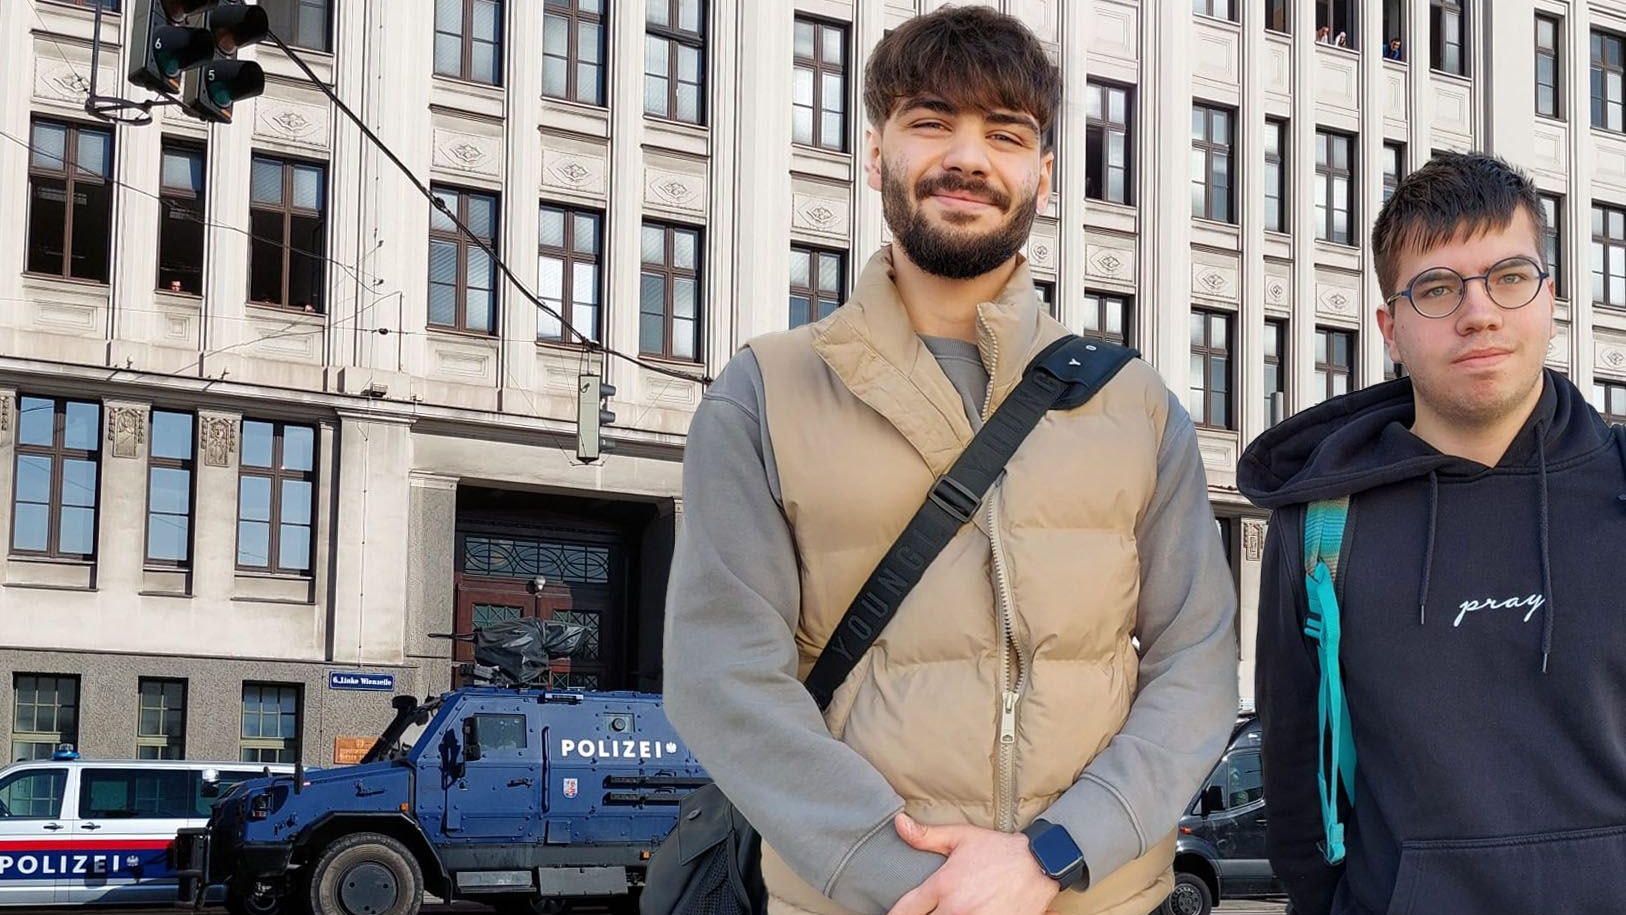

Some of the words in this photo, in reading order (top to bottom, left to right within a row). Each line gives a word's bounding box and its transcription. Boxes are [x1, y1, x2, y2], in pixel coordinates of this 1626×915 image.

[154, 37, 162, 50] 6
[208, 69, 215, 81] 5
[1453, 594, 1546, 627] pray
[561, 739, 662, 758] POLIZEI
[0, 855, 120, 874] POLIZEI
